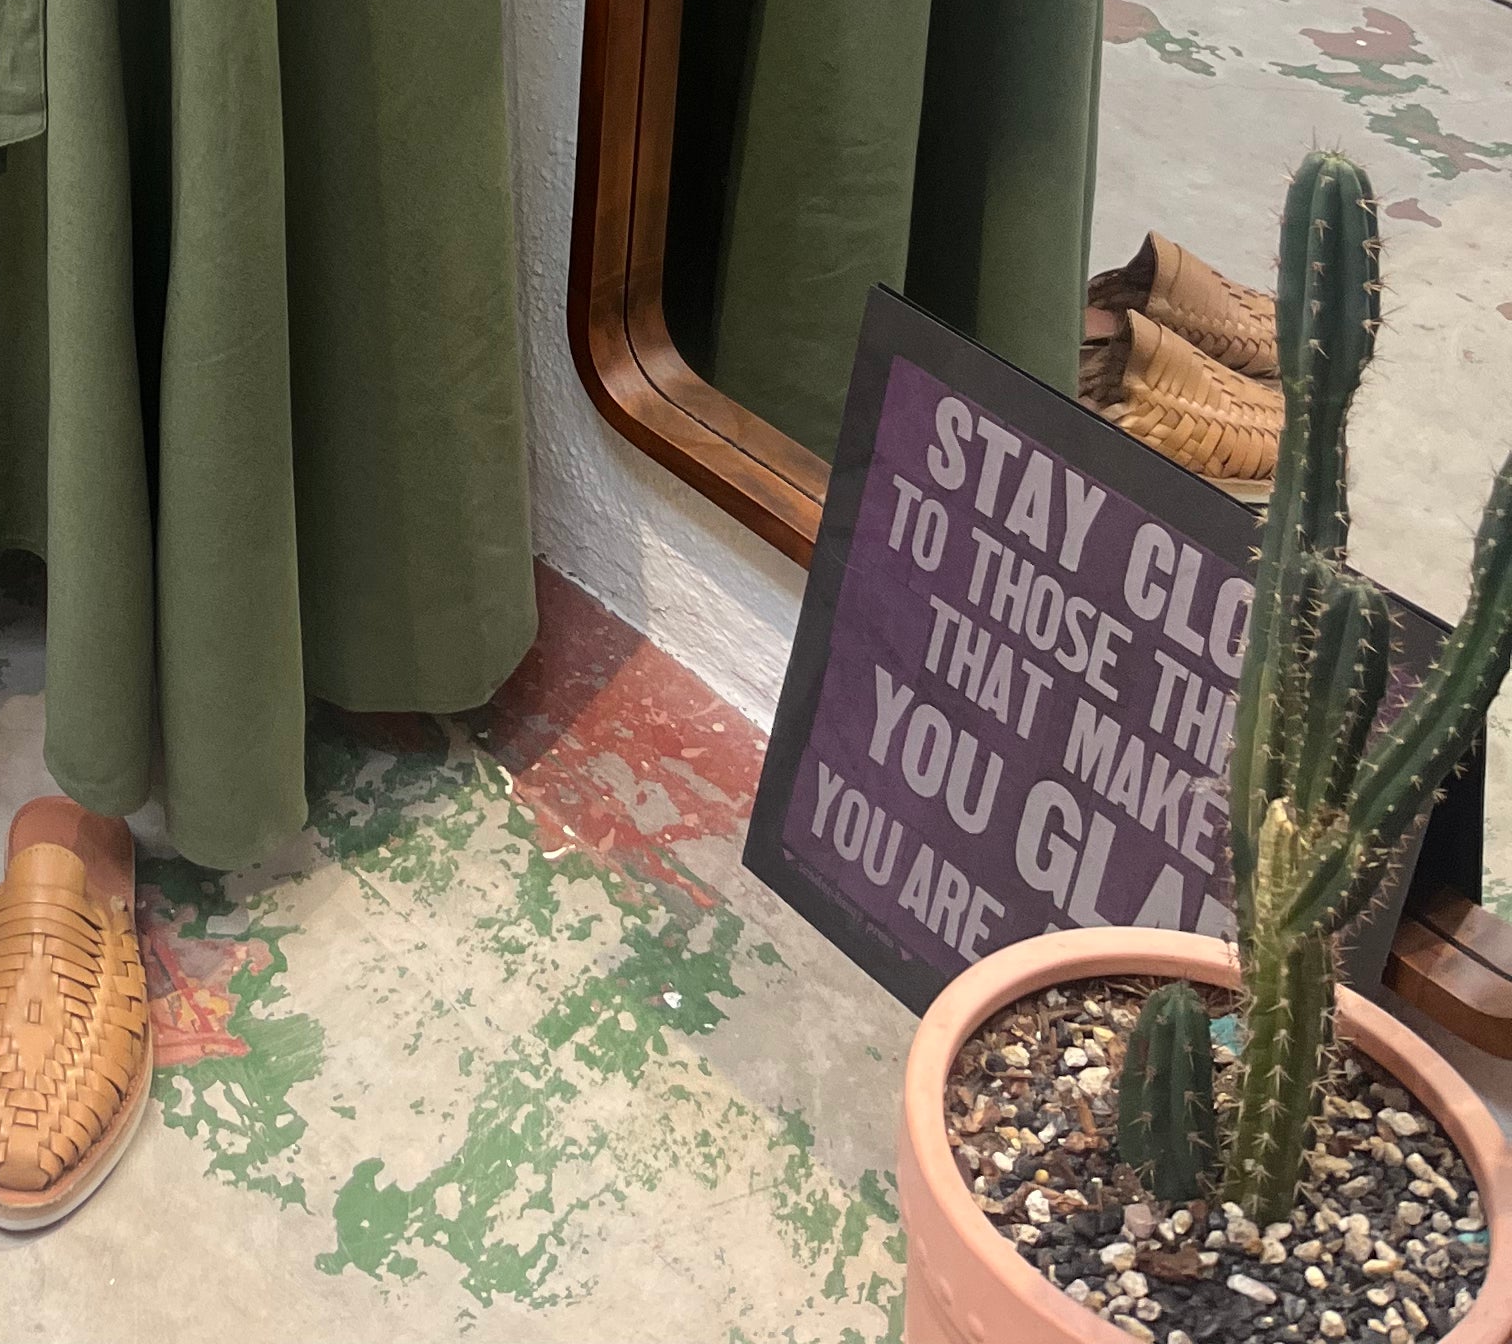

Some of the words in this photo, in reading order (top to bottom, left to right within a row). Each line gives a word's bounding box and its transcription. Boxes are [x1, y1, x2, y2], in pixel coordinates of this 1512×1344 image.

[888, 474, 949, 572] TO
[967, 526, 1134, 702] THOSE
[1149, 648, 1237, 784] THI
[926, 396, 1108, 573] STAY
[1123, 522, 1255, 680] CLO
[811, 761, 904, 885] YOU
[897, 843, 1006, 965] ARE
[867, 663, 1005, 835] YOU
[924, 594, 1054, 740] THAT
[1062, 697, 1231, 875] MAKE
